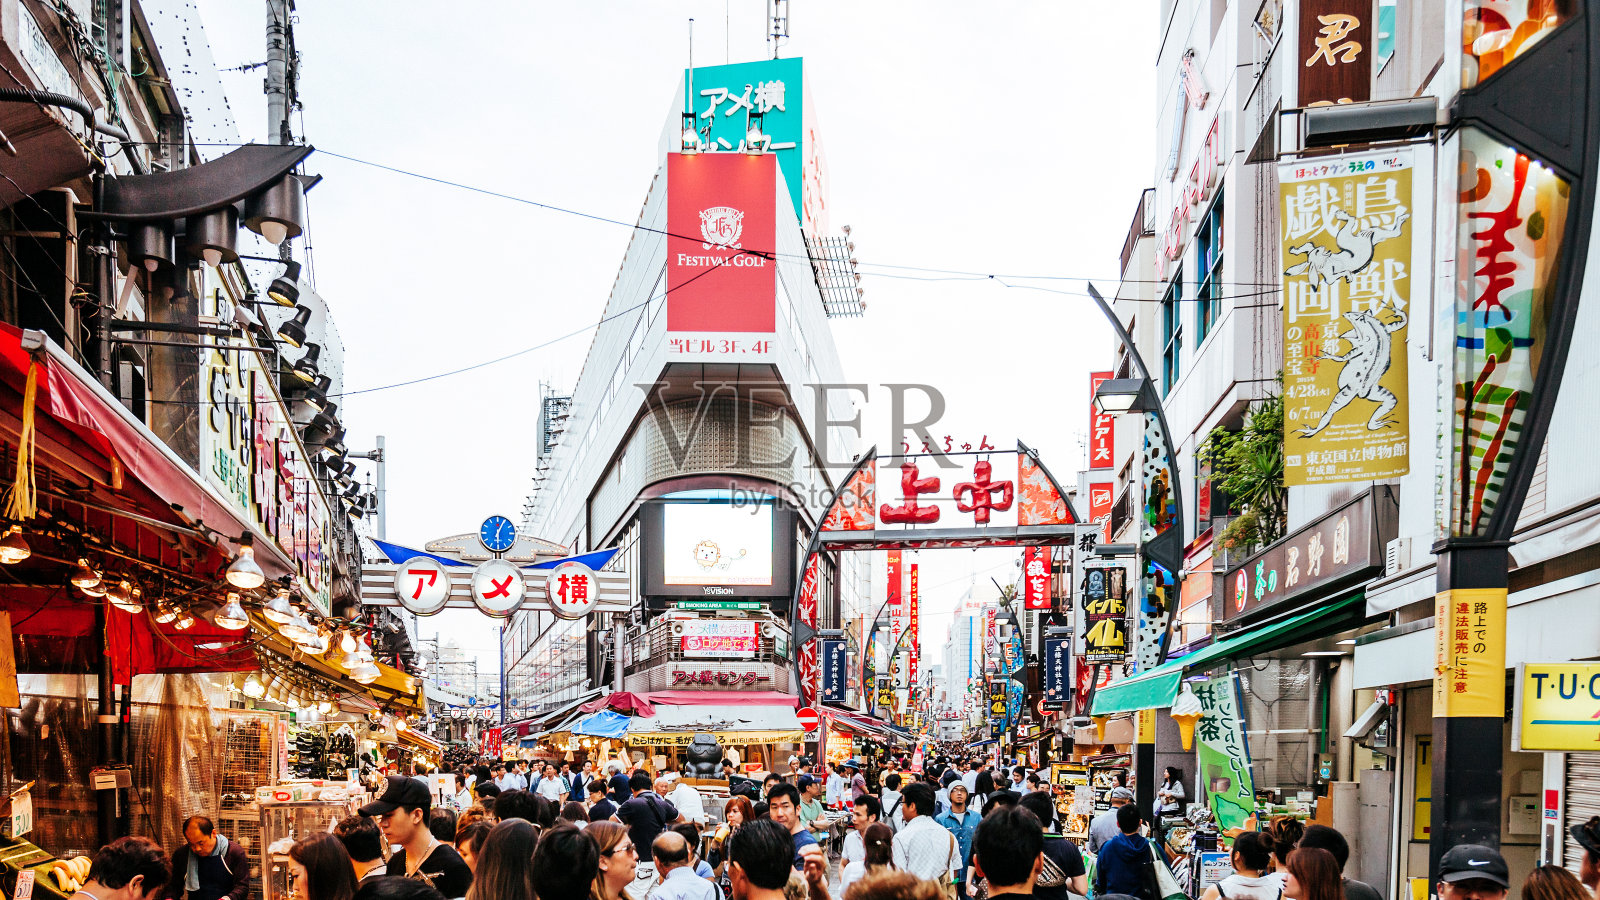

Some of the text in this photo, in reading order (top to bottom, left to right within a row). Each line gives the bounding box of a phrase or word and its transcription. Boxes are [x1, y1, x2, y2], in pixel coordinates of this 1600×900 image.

[700, 80, 786, 119] アメ横
[677, 254, 767, 267] FESTIVAL GOLF
[1287, 326, 1302, 375] の至宝
[1305, 442, 1407, 465] 東京国立博物館
[880, 461, 1014, 524] 上中
[408, 569, 589, 605] アメ横
[1085, 598, 1126, 614] インドの
[1473, 602, 1488, 654] 路上での
[1454, 602, 1469, 694] 違法販売に注意
[672, 670, 769, 685] アメ横センター
[452, 709, 491, 718] アメ横
[632, 736, 671, 745] たらばがに
